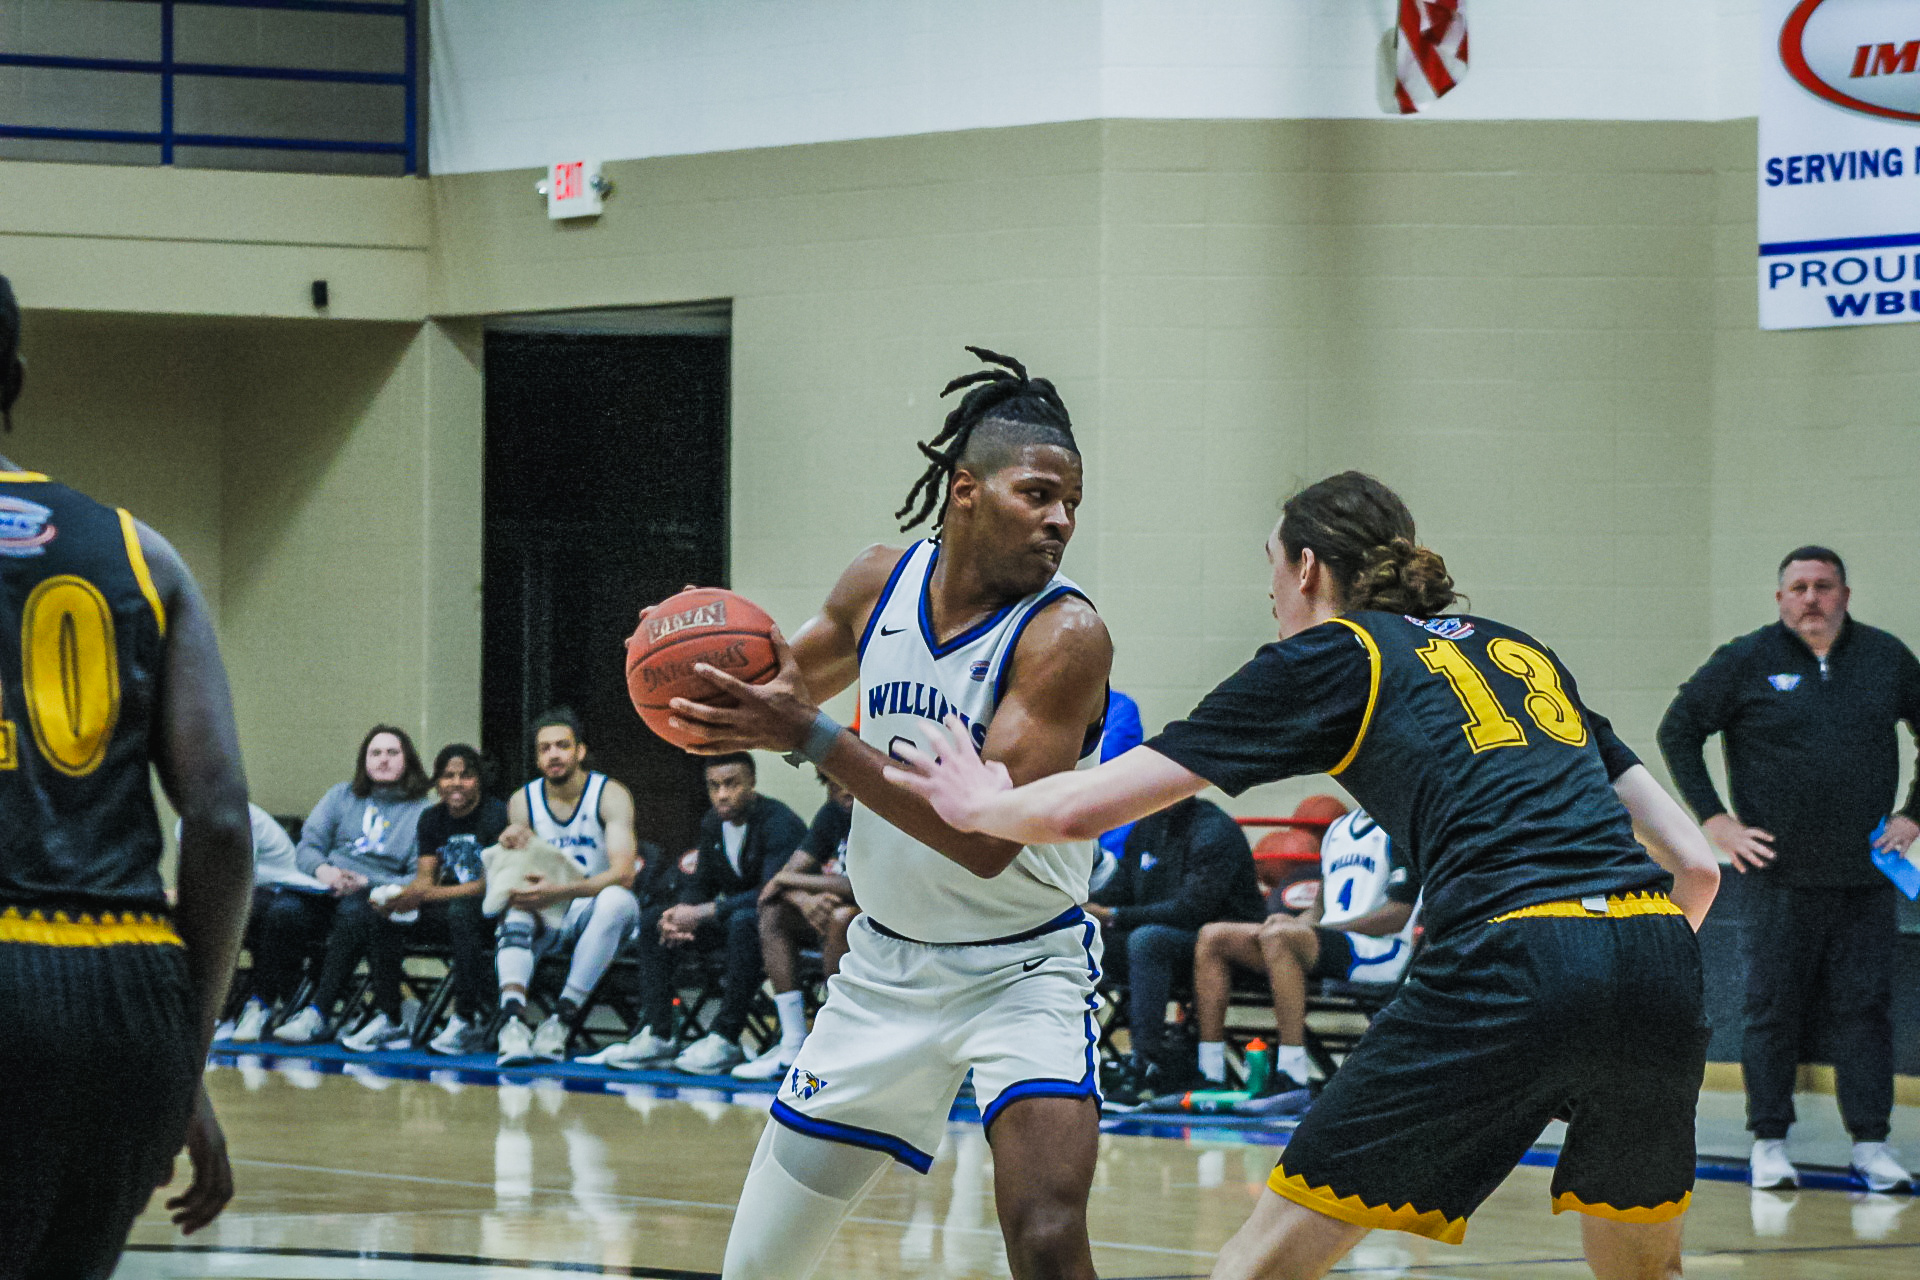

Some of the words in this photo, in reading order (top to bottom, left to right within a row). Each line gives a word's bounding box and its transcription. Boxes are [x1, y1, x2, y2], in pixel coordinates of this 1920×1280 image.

[1765, 148, 1903, 187] SERVING
[1769, 253, 1920, 289] PROU
[1415, 637, 1587, 754] 13
